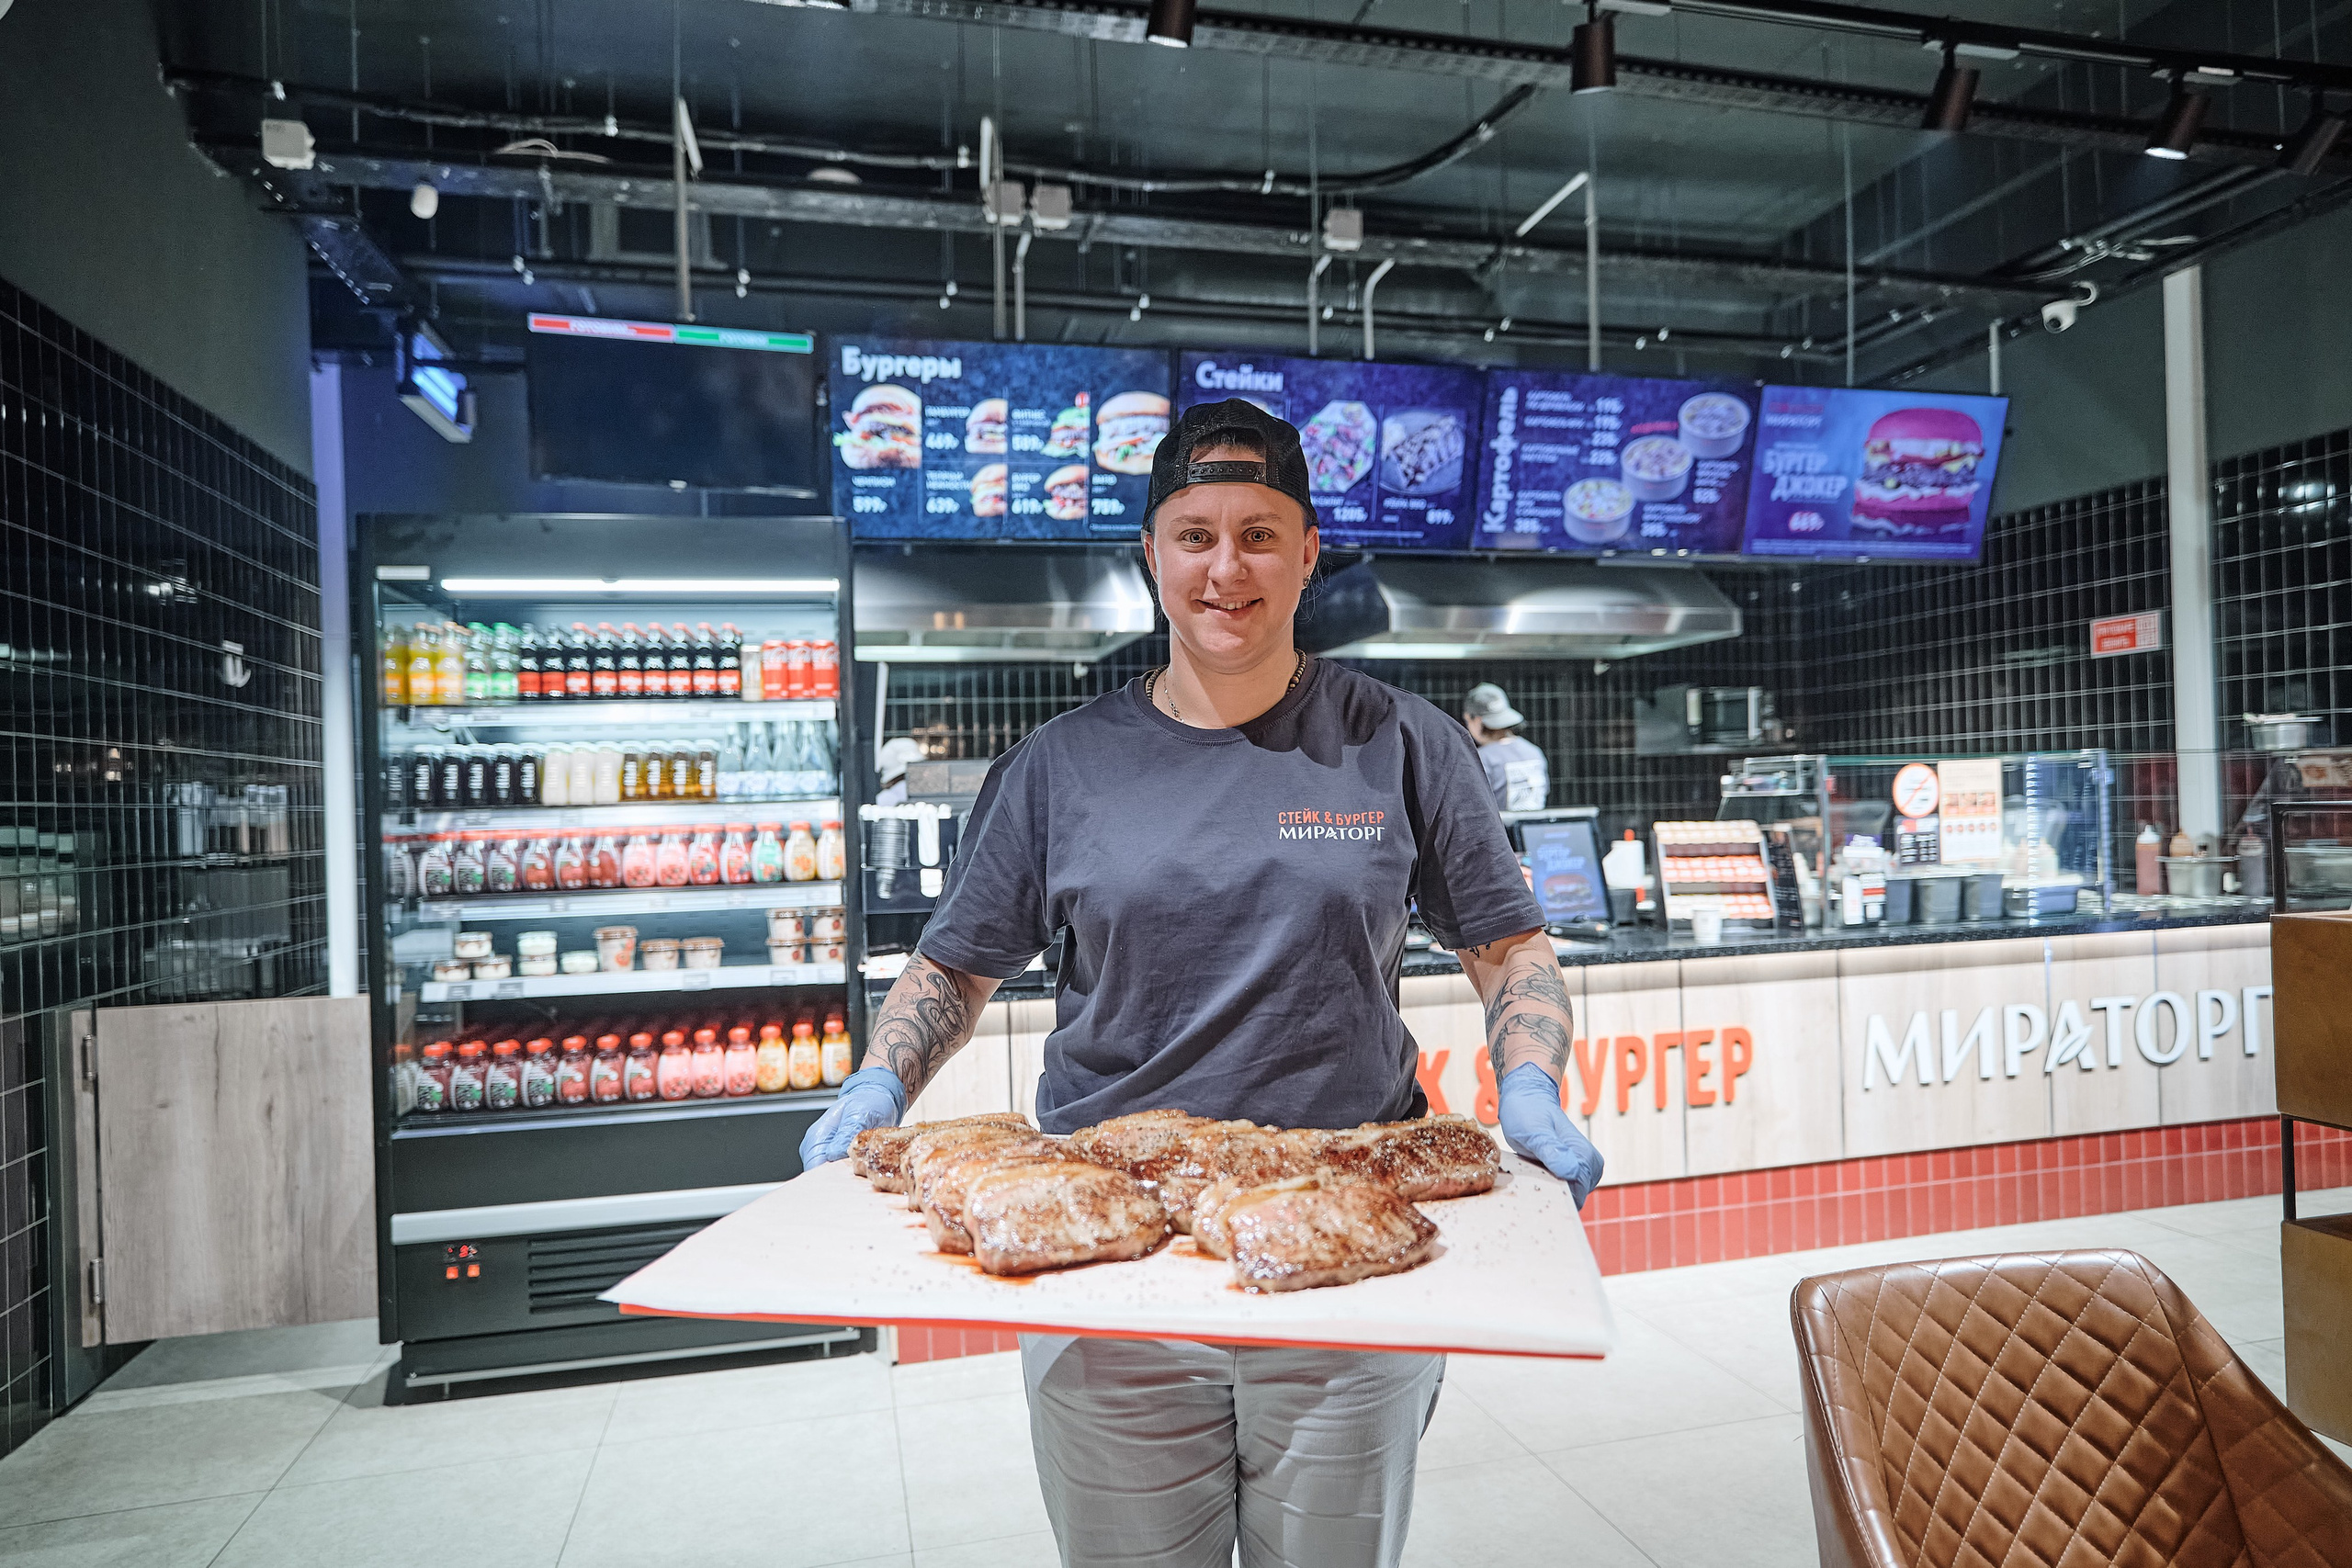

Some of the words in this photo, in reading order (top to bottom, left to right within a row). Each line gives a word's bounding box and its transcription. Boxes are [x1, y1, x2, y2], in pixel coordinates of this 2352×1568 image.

[840, 344, 962, 383] Бургеры
[1195, 360, 1283, 392] Стейки
[1482, 386, 1519, 533] Картофель
[1278, 808, 1320, 825] СТЕЙК
[1324, 811, 1332, 824] &
[1336, 811, 1385, 825] БУРГЕР
[1279, 826, 1385, 840] МИРАТОРГ
[1863, 986, 2274, 1091] МИРАТОРГ
[1559, 1026, 1753, 1116] УРГЕР
